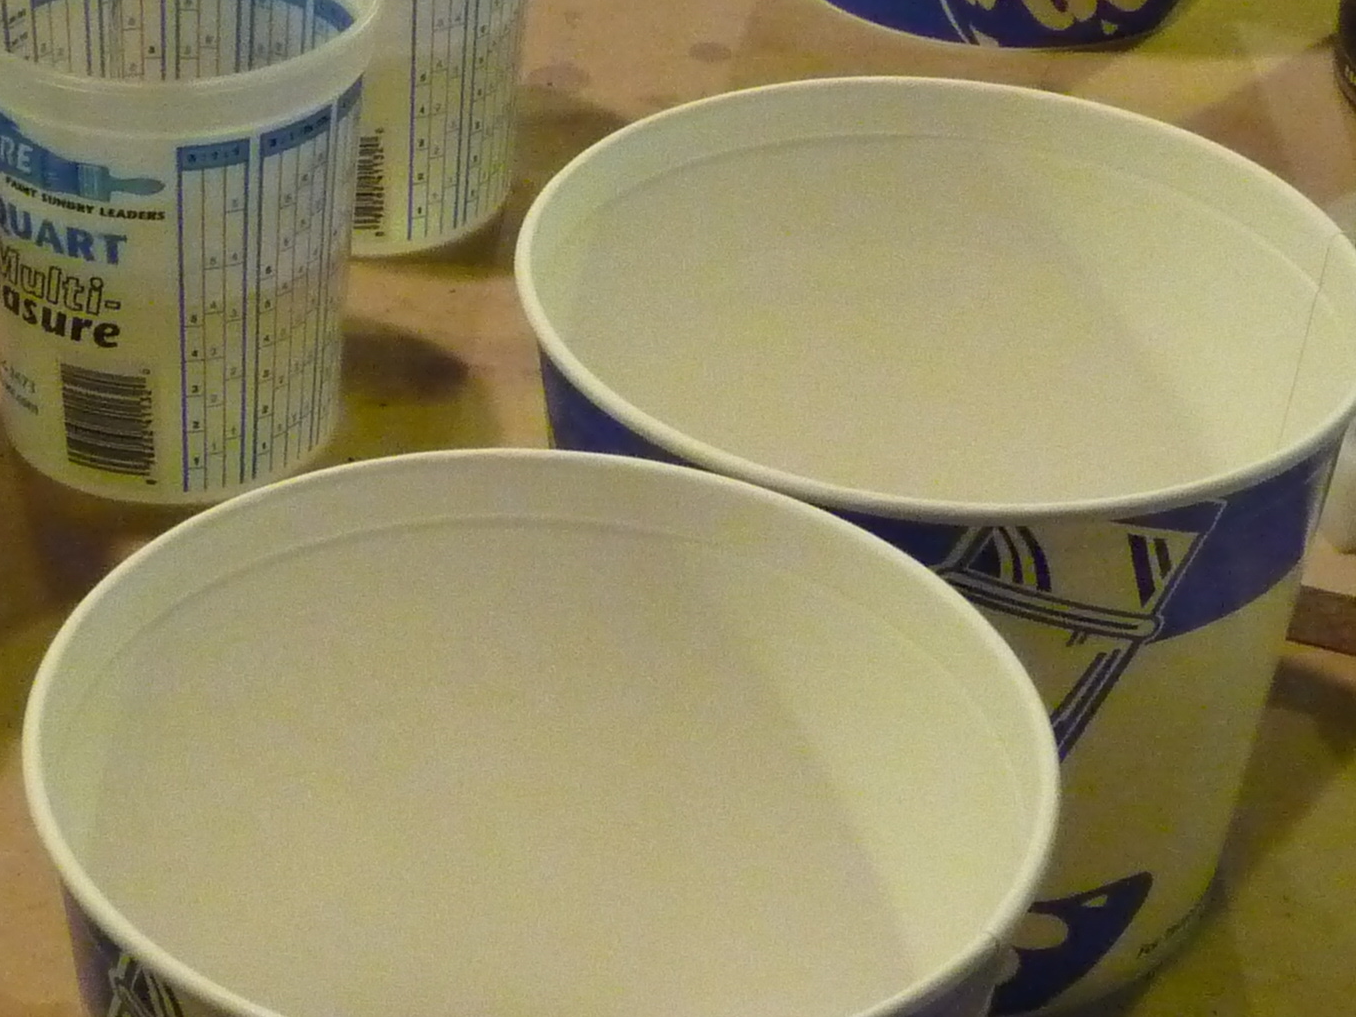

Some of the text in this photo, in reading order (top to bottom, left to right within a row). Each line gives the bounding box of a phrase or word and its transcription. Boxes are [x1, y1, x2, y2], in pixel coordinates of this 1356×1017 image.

[6, 177, 167, 222] PAINT SUNDRY LEADERS
